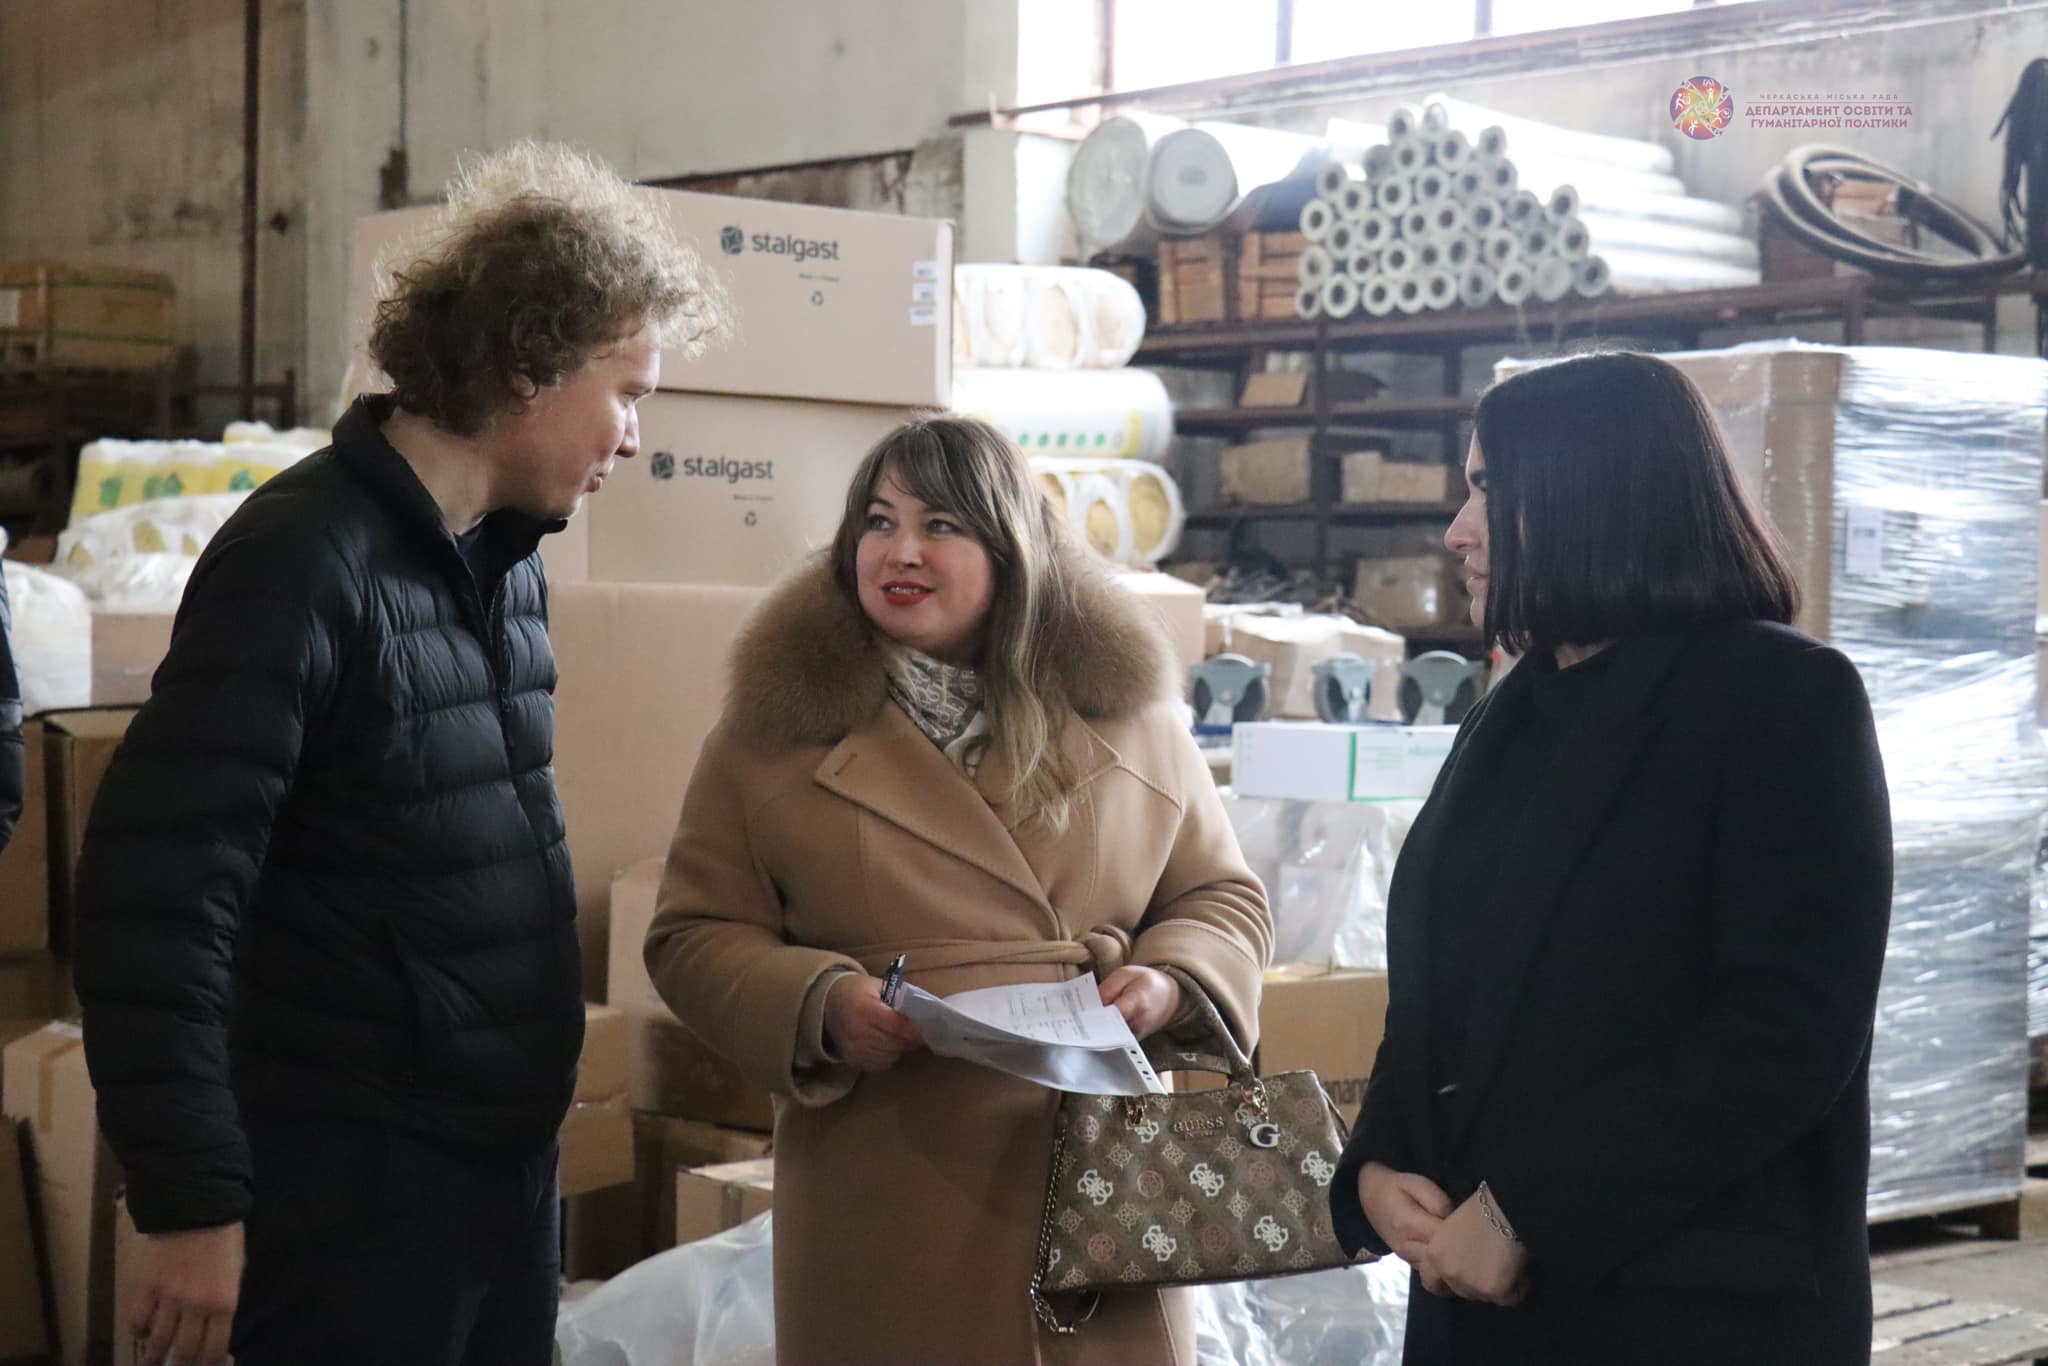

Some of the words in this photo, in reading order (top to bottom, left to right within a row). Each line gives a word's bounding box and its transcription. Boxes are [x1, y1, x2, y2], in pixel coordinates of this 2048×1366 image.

[752, 233, 840, 262] stalgast
[683, 456, 774, 484] stalgast
[1249, 1122, 1281, 1148] G
